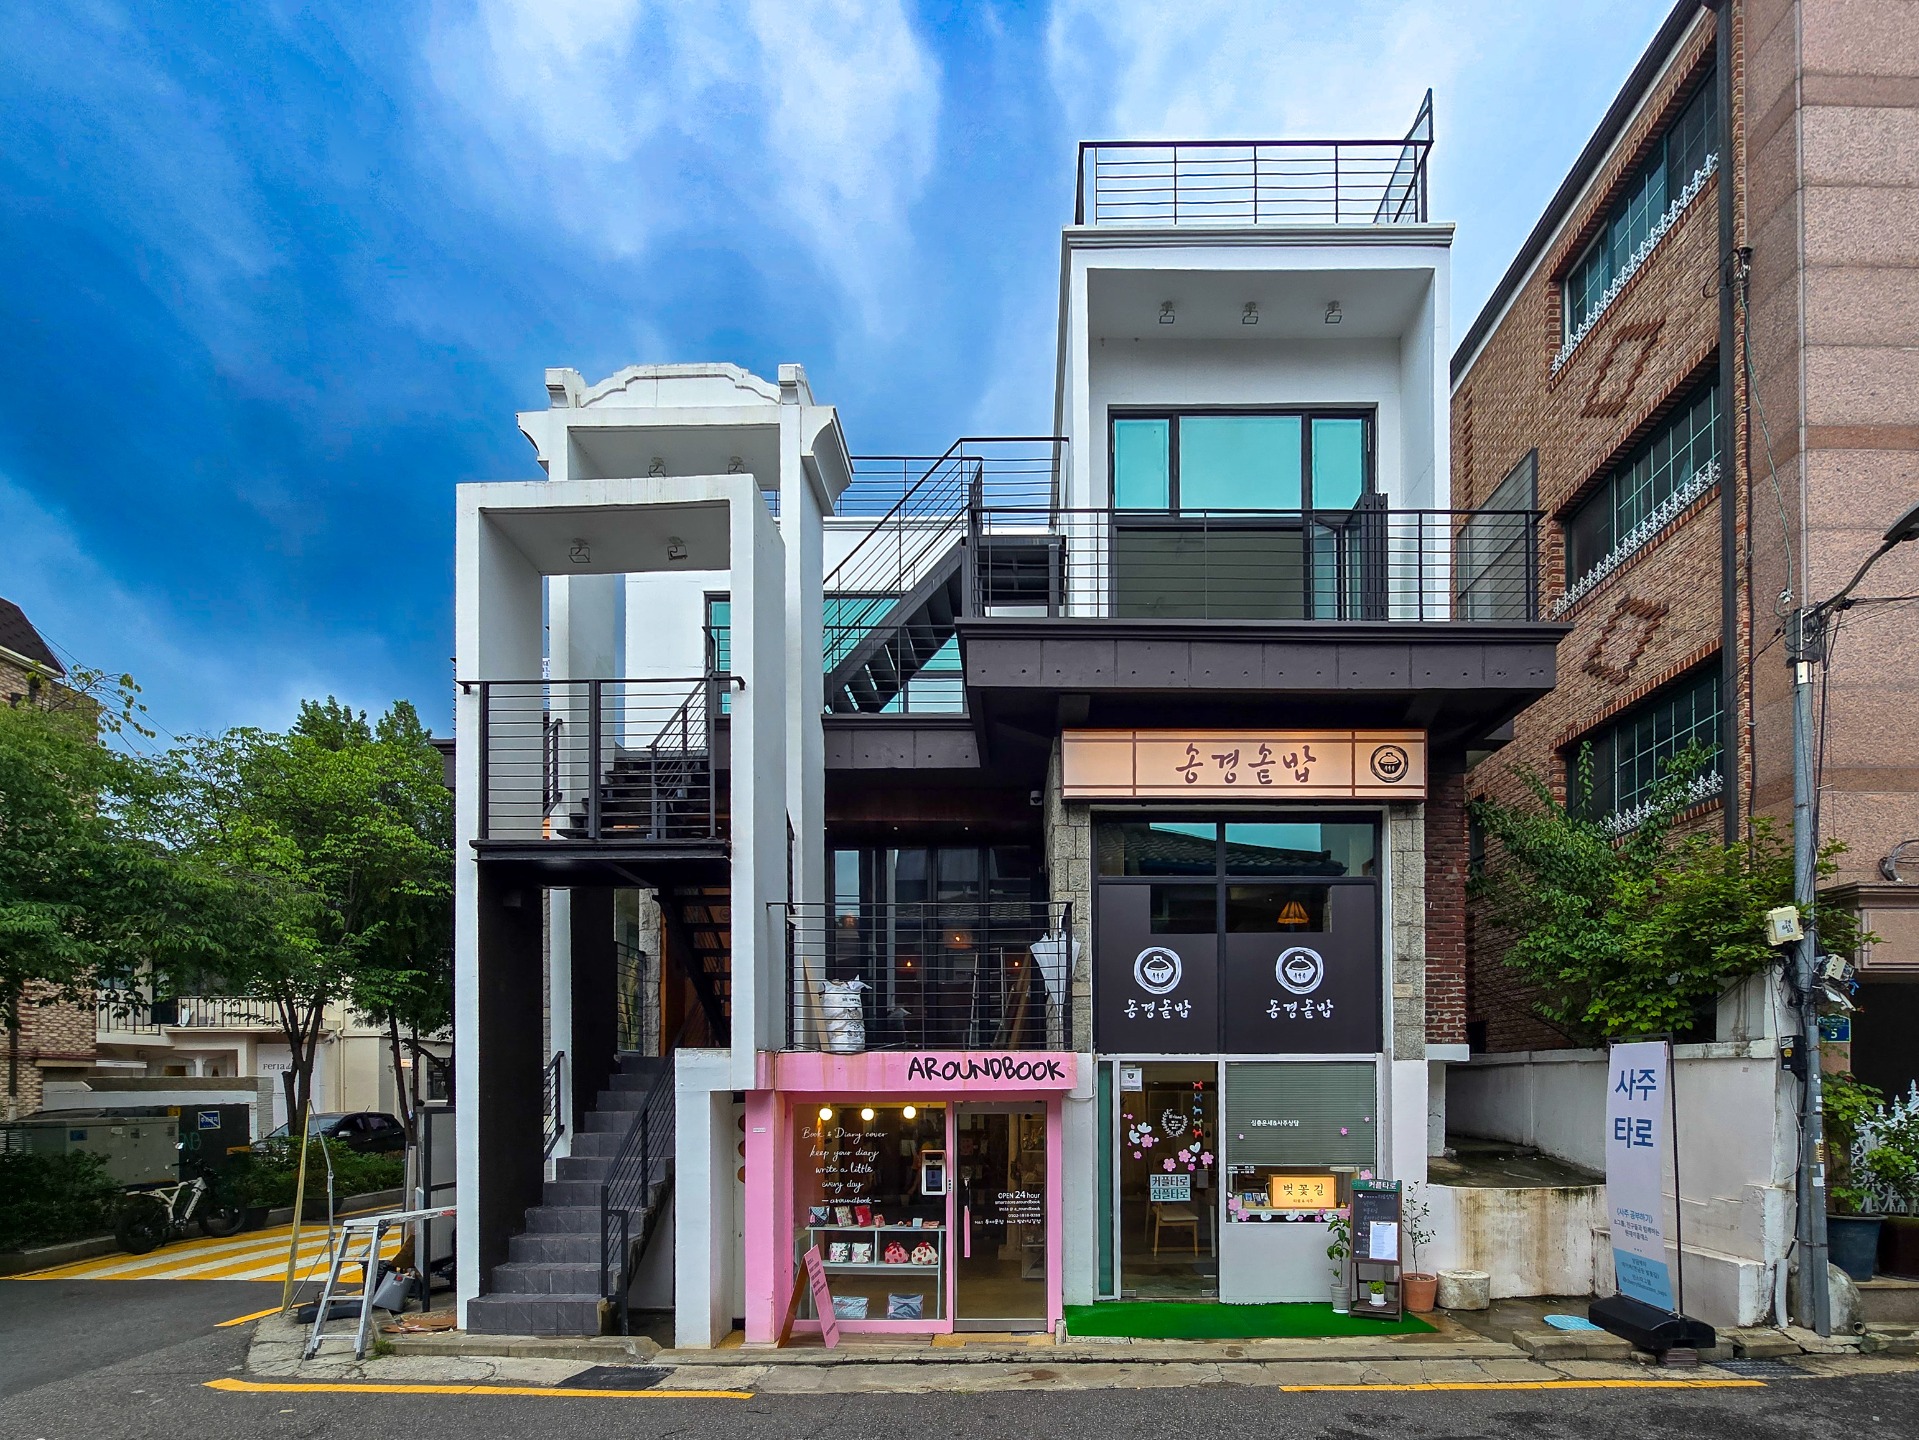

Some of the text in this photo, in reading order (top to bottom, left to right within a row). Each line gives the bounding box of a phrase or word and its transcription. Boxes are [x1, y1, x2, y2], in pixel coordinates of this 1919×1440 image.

[1175, 743, 1317, 785] 송경솥밥
[1124, 999, 1192, 1019] 송경솥밥
[1266, 999, 1334, 1019] 송경솥밥
[1831, 1028, 1838, 1039] 5
[908, 1056, 1066, 1081] AROUNDBOOK
[1615, 1069, 1657, 1101] 사주
[802, 1127, 824, 1138] Book
[834, 1127, 863, 1144] Diary
[1615, 1117, 1654, 1149] 타로
[810, 1145, 879, 1162] keep your diary
[816, 1164, 838, 1173] write
[850, 1162, 873, 1173] little
[821, 1180, 864, 1194] every day
[1152, 1176, 1188, 1187] 커플타로
[1368, 1181, 1397, 1190] 커플타로
[1015, 1190, 1026, 1199] 24
[1152, 1189, 1189, 1200] 심플타로
